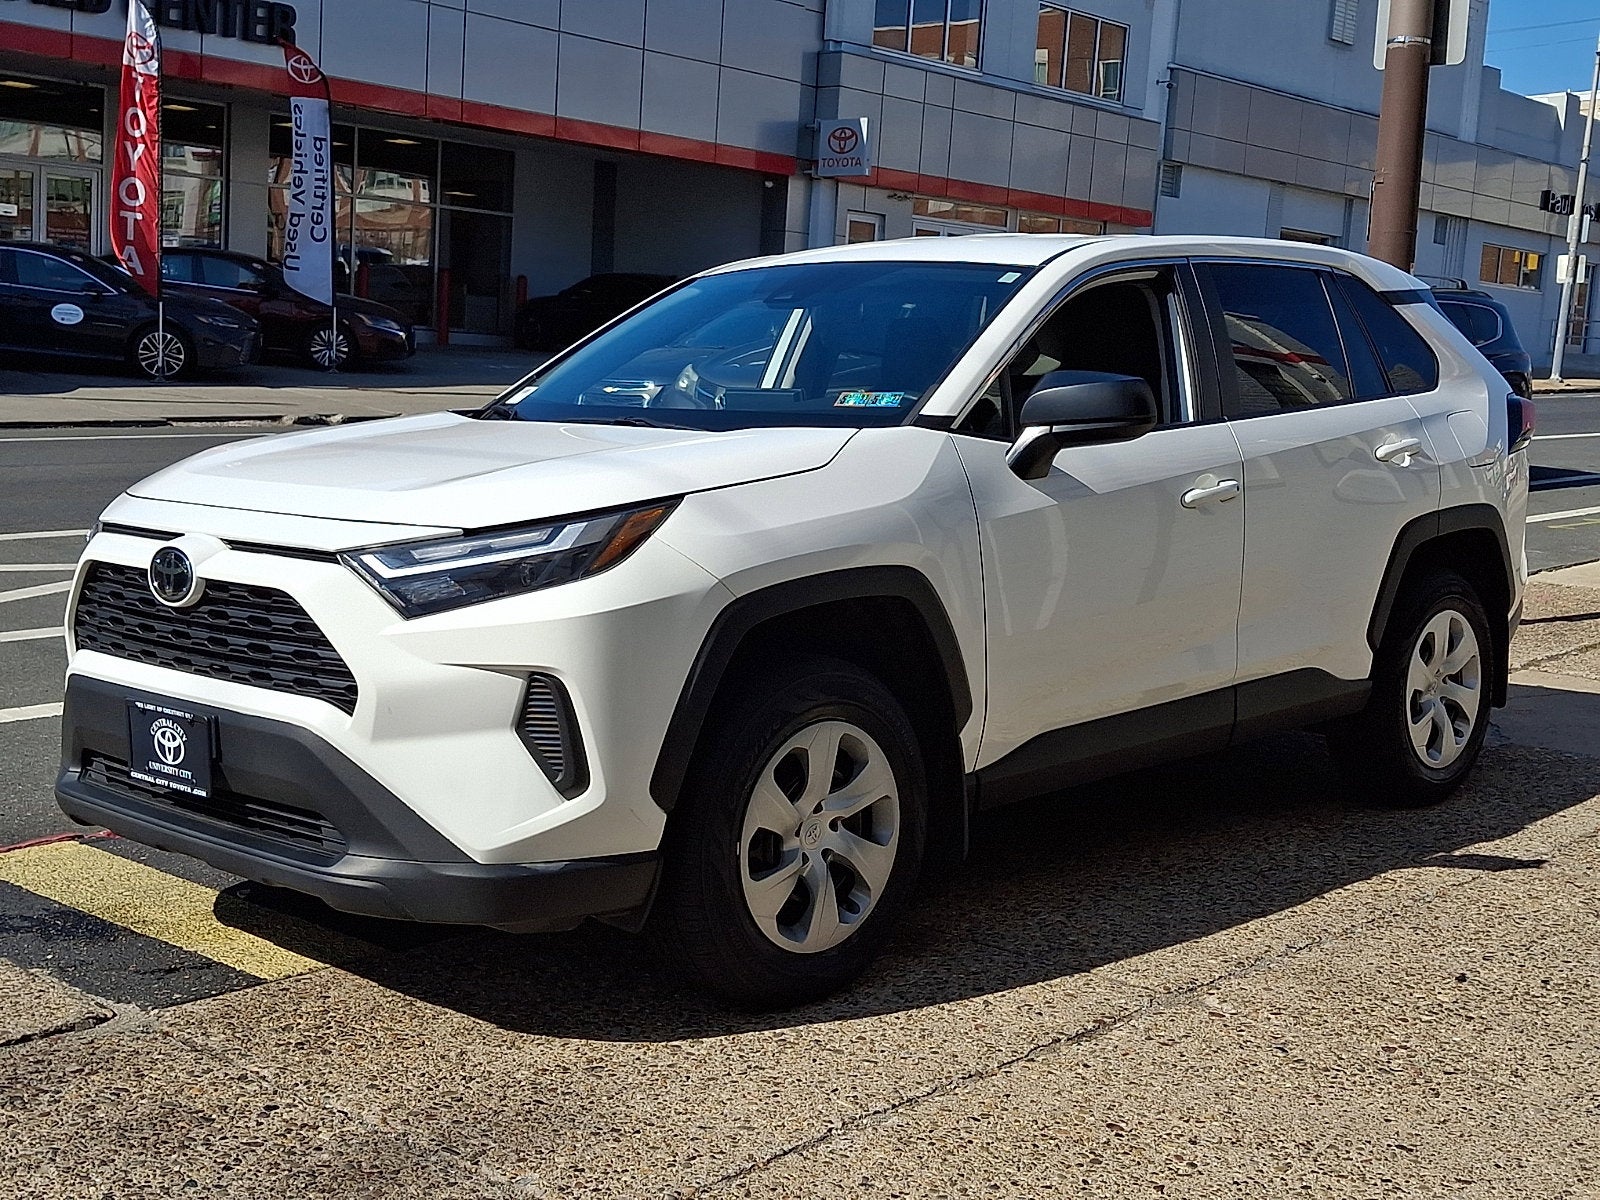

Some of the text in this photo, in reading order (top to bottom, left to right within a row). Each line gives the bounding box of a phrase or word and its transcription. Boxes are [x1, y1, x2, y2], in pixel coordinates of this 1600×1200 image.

[150, 0, 297, 47] ENTER
[821, 156, 862, 168] TOYOTA
[118, 72, 147, 277] TOYOTA
[1548, 191, 1572, 215] Paul
[150, 718, 188, 741] CENTRAL CITY
[148, 760, 192, 780] UNIVERSITY CITY
[130, 771, 155, 783] CENTRAL
[155, 777, 169, 787] CITY
[169, 782, 192, 793] TOYOTA
